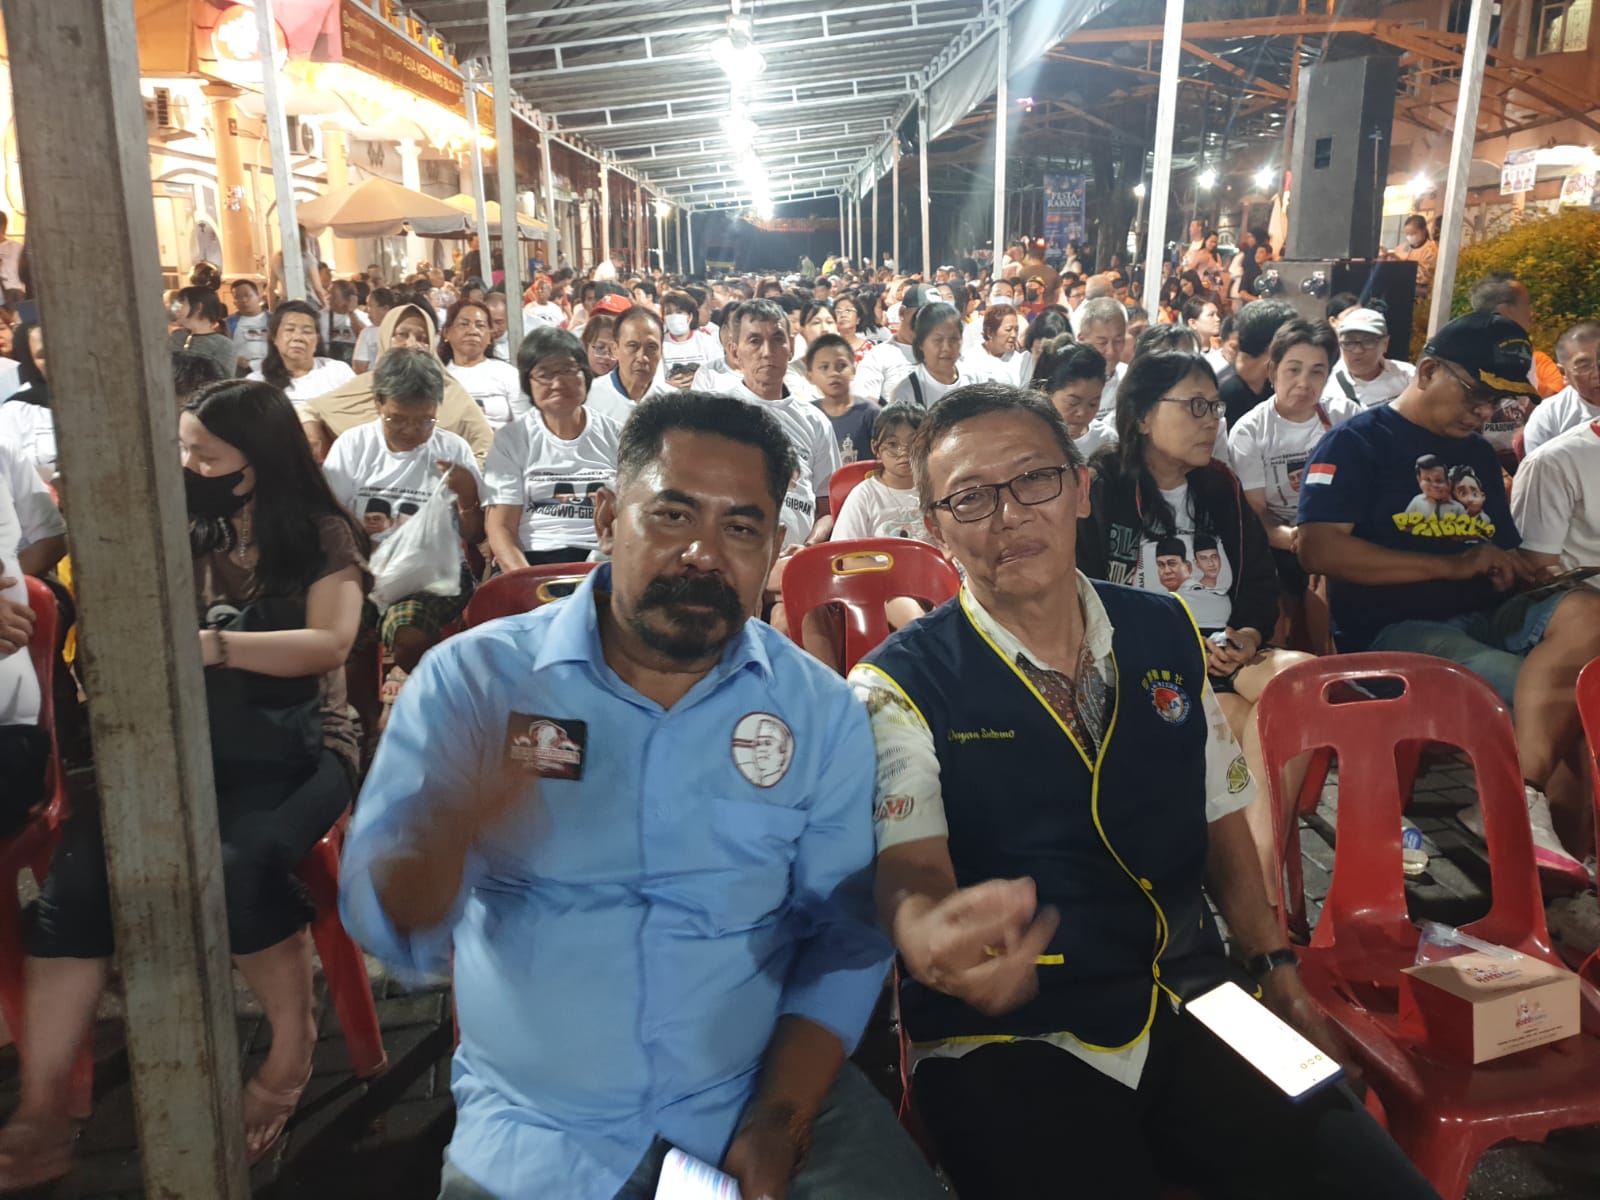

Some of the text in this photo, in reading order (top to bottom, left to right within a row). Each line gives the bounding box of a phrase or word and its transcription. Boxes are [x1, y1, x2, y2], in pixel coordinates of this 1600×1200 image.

[1051, 191, 1078, 200] PESTA
[1048, 199, 1081, 208] RAKYAT
[526, 501, 594, 520] PRABOWO-GIB
[785, 496, 812, 517] GIBRAN
